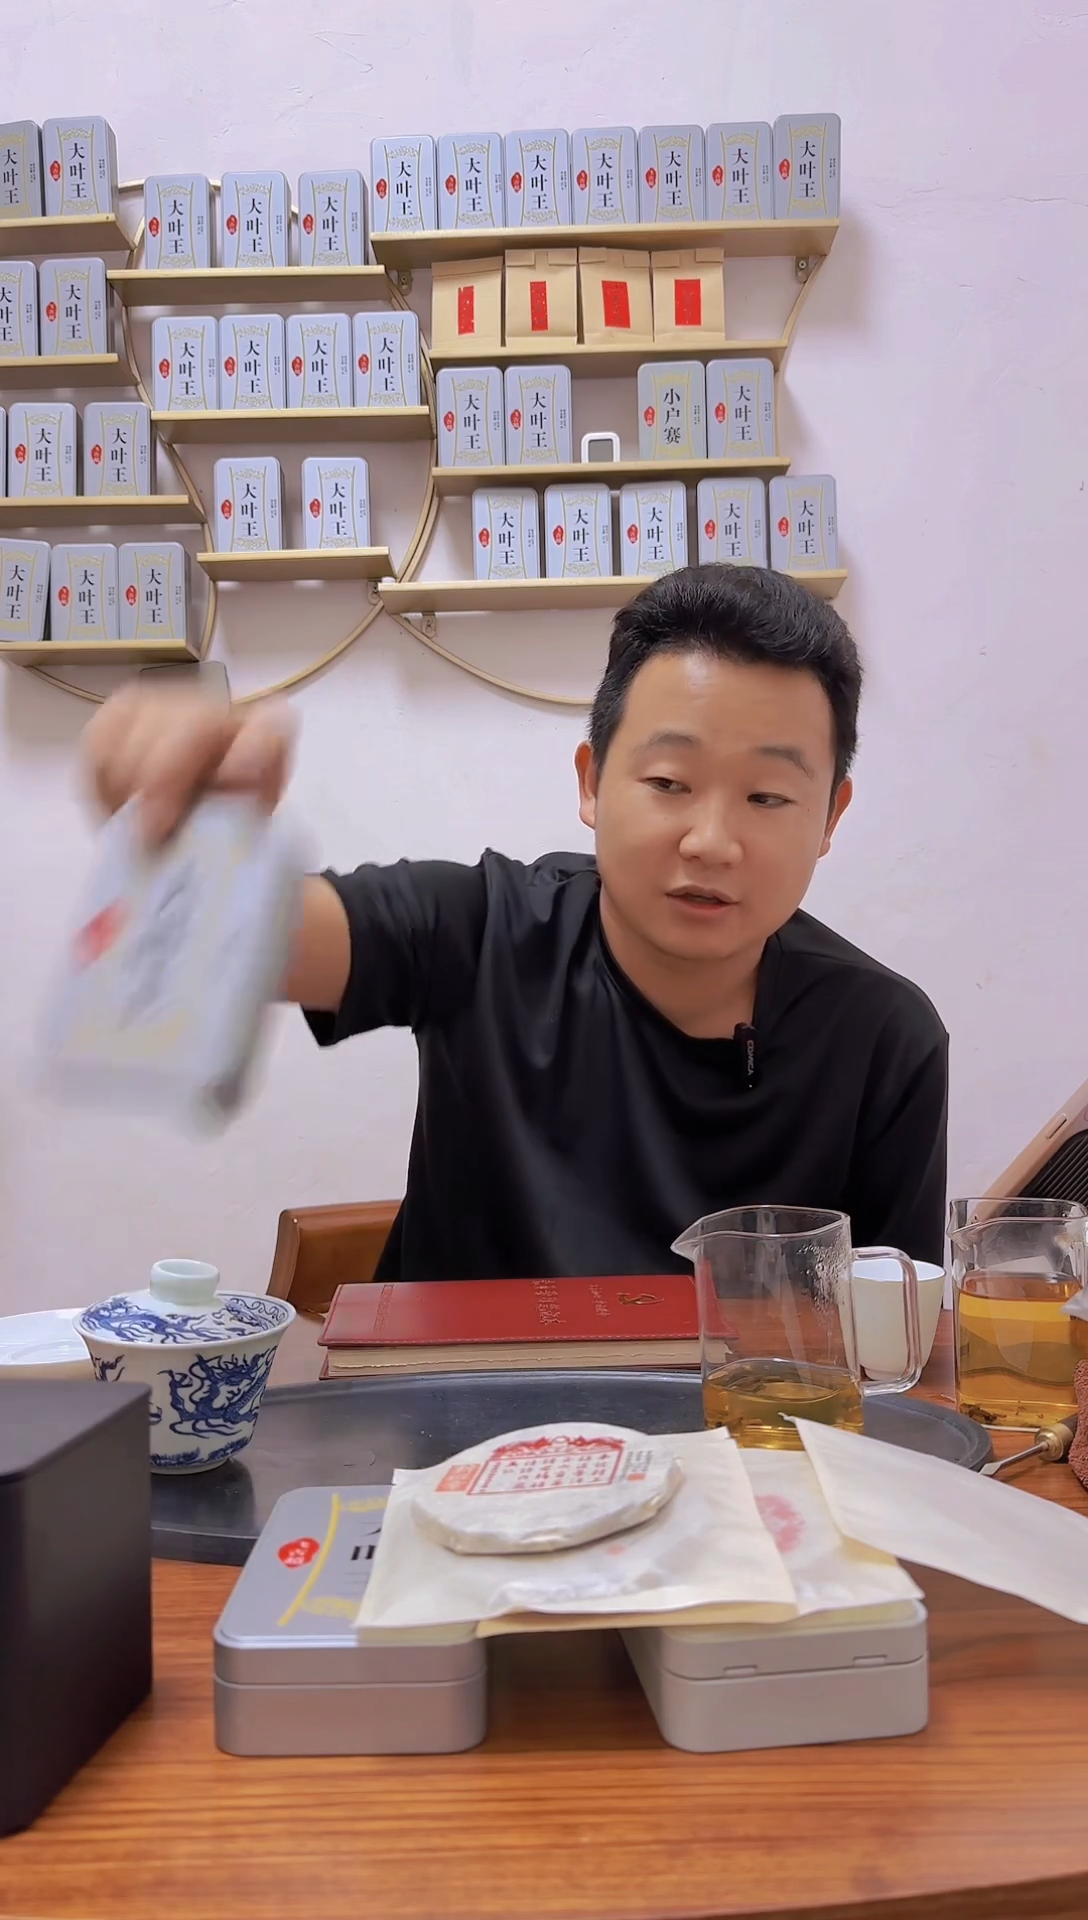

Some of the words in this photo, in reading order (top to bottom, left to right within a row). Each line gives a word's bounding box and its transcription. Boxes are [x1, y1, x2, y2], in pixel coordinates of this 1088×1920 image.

[2, 149, 19, 204] 大叶王
[69, 143, 87, 199] 大叶王
[396, 161, 413, 216] 大叶王
[465, 157, 483, 212] 大叶王
[531, 155, 548, 209] 大叶王
[597, 153, 614, 208] 大叶王
[665, 151, 683, 206] 大叶王
[732, 148, 749, 204] 大叶王
[799, 141, 816, 198] 大叶王
[168, 200, 185, 254] 大叶王
[246, 198, 264, 253] 大叶王
[322, 196, 338, 252] 大叶王
[65, 284, 82, 339] 大叶王
[179, 343, 196, 395] 大叶王
[244, 341, 261, 393] 大叶王
[311, 341, 328, 392] 大叶王
[378, 339, 395, 391] 大叶王
[463, 394, 481, 449] 大叶王
[530, 392, 548, 448] 大叶王
[663, 388, 681, 445] 小户赛
[734, 385, 752, 441] 大叶王
[35, 428, 52, 482] 大叶王
[111, 428, 127, 482] 大叶王
[241, 483, 258, 536] 大叶王
[330, 483, 347, 536] 大叶王
[572, 509, 590, 563] 大叶王
[647, 507, 664, 561] 大叶王
[724, 503, 742, 557] 大叶王
[798, 500, 815, 554] 大叶王
[498, 513, 515, 566] 大叶王
[6, 565, 25, 619] 大叶王
[78, 570, 95, 624] 大叶王
[145, 569, 162, 623] 大叶王
[746, 1039, 755, 1076] COMICA
